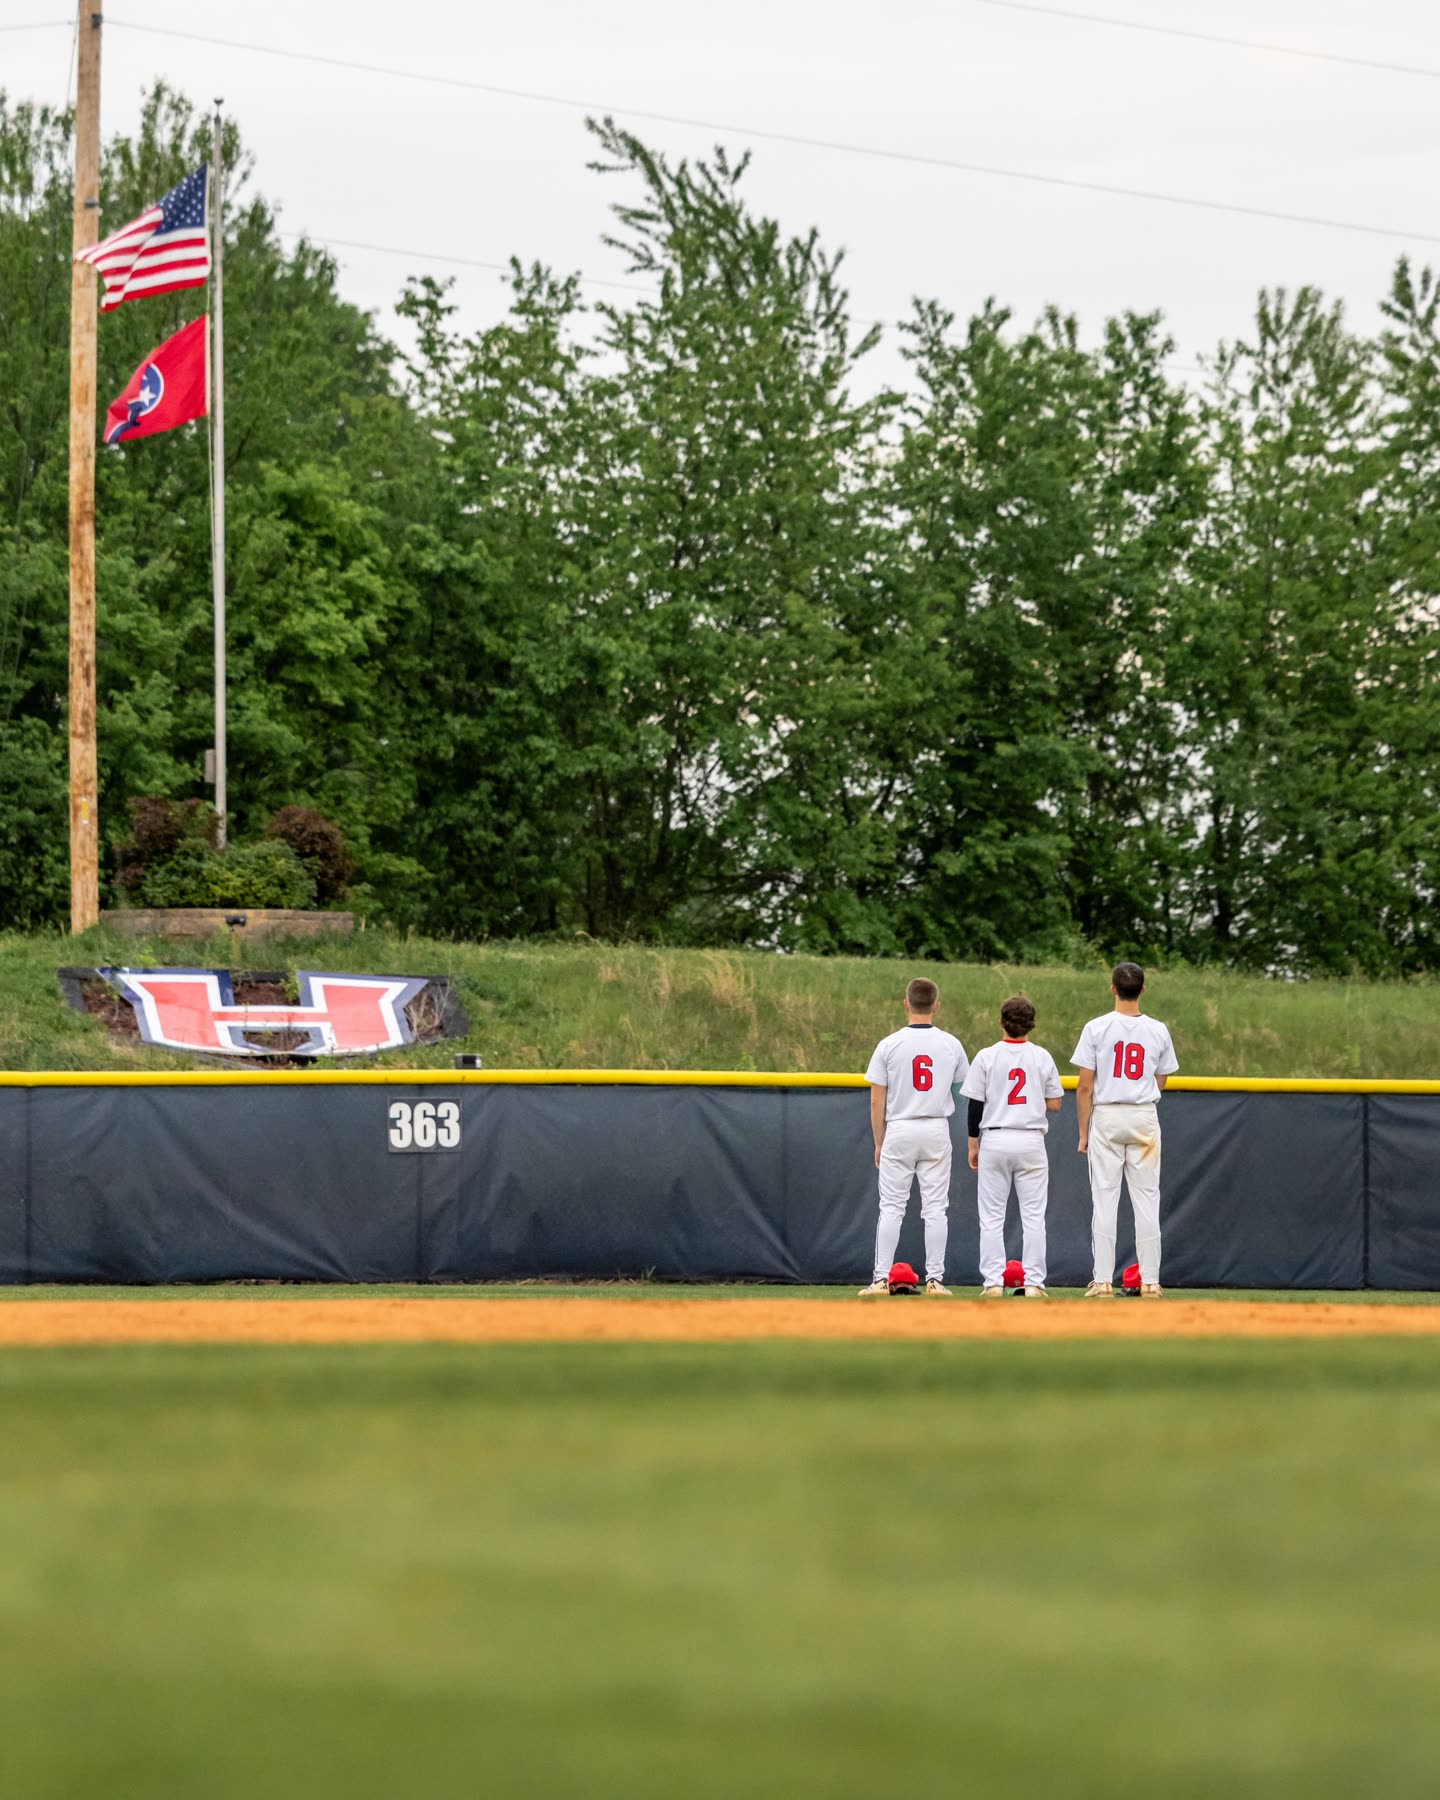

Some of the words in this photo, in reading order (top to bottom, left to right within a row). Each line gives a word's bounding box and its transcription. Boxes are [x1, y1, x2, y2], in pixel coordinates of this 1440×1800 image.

[912, 1054, 933, 1091] 6
[1113, 1038, 1145, 1080] 18
[1007, 1067, 1027, 1105] 2
[389, 1101, 461, 1148] 363
